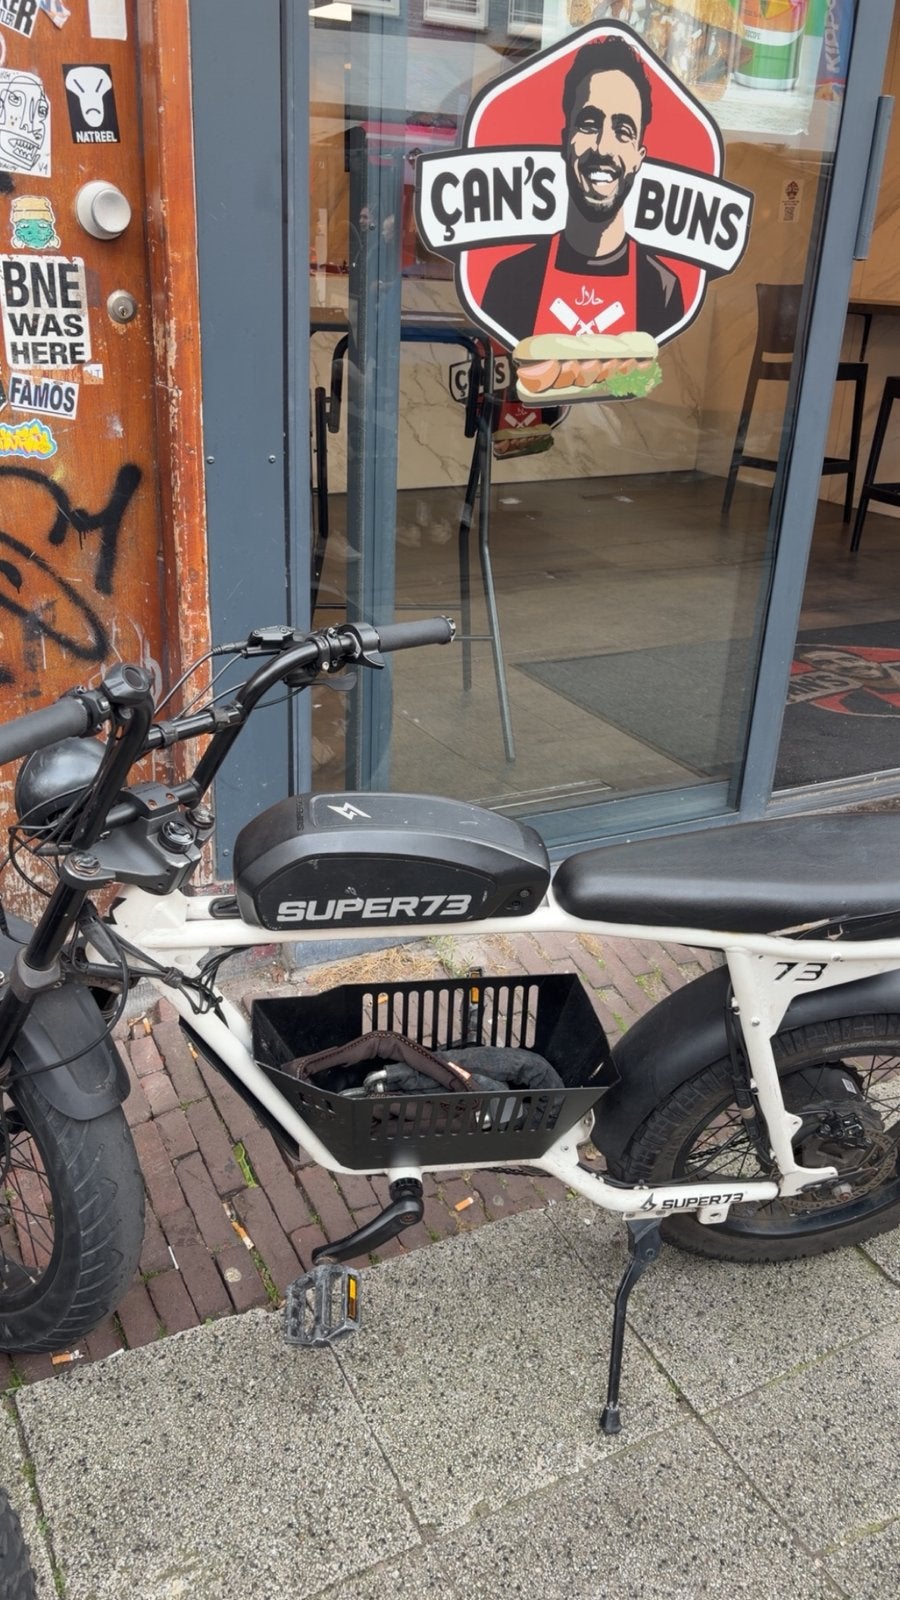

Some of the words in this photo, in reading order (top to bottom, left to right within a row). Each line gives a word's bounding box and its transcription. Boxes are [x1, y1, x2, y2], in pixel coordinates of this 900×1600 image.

[76, 131, 117, 143] NATREEL
[430, 156, 556, 241] ÇAN'S
[634, 177, 744, 251] BUNS
[3, 261, 82, 308] BNE
[575, 285, 604, 306] حلال
[8, 313, 84, 337] WAS
[10, 342, 86, 365] HERE
[276, 894, 472, 922] SUPER73
[774, 962, 828, 981] 73
[661, 1192, 744, 1210] SUPER73
